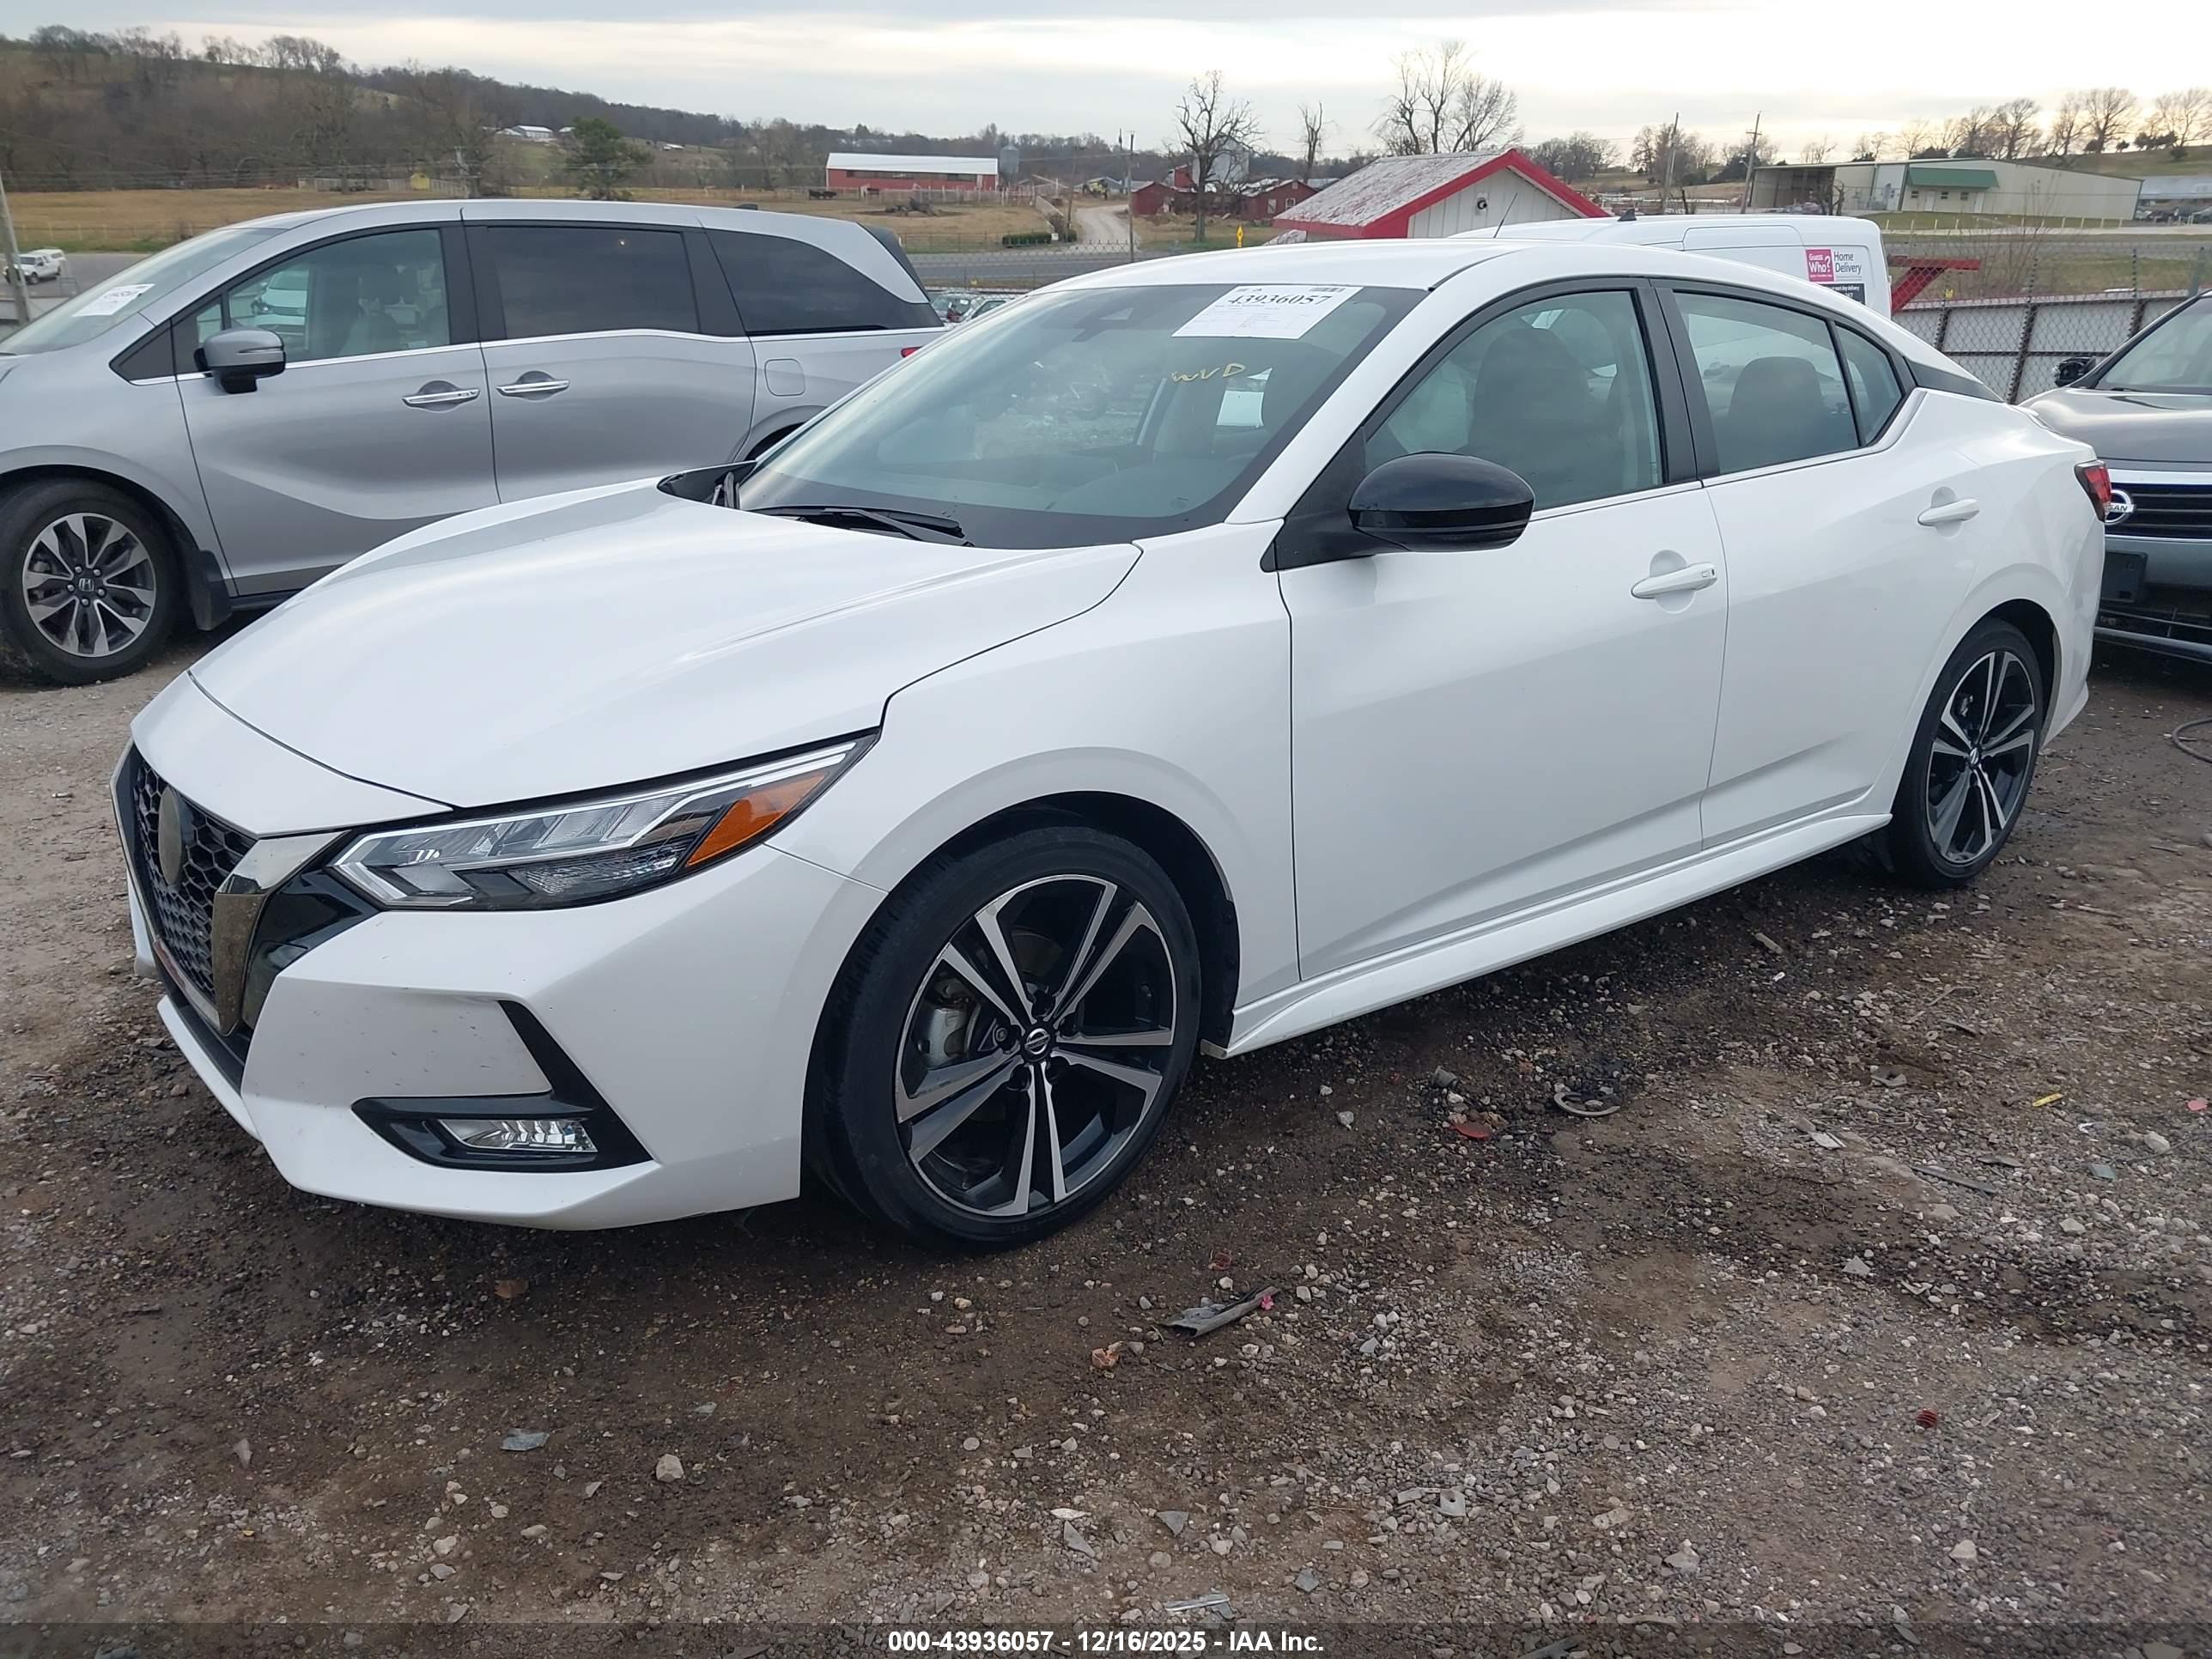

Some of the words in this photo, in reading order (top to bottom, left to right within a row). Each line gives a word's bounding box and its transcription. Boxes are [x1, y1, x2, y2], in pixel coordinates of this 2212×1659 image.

[1833, 251, 1854, 261] Home
[1835, 262, 1862, 275] Delivery
[1227, 295, 1333, 305] 43936057
